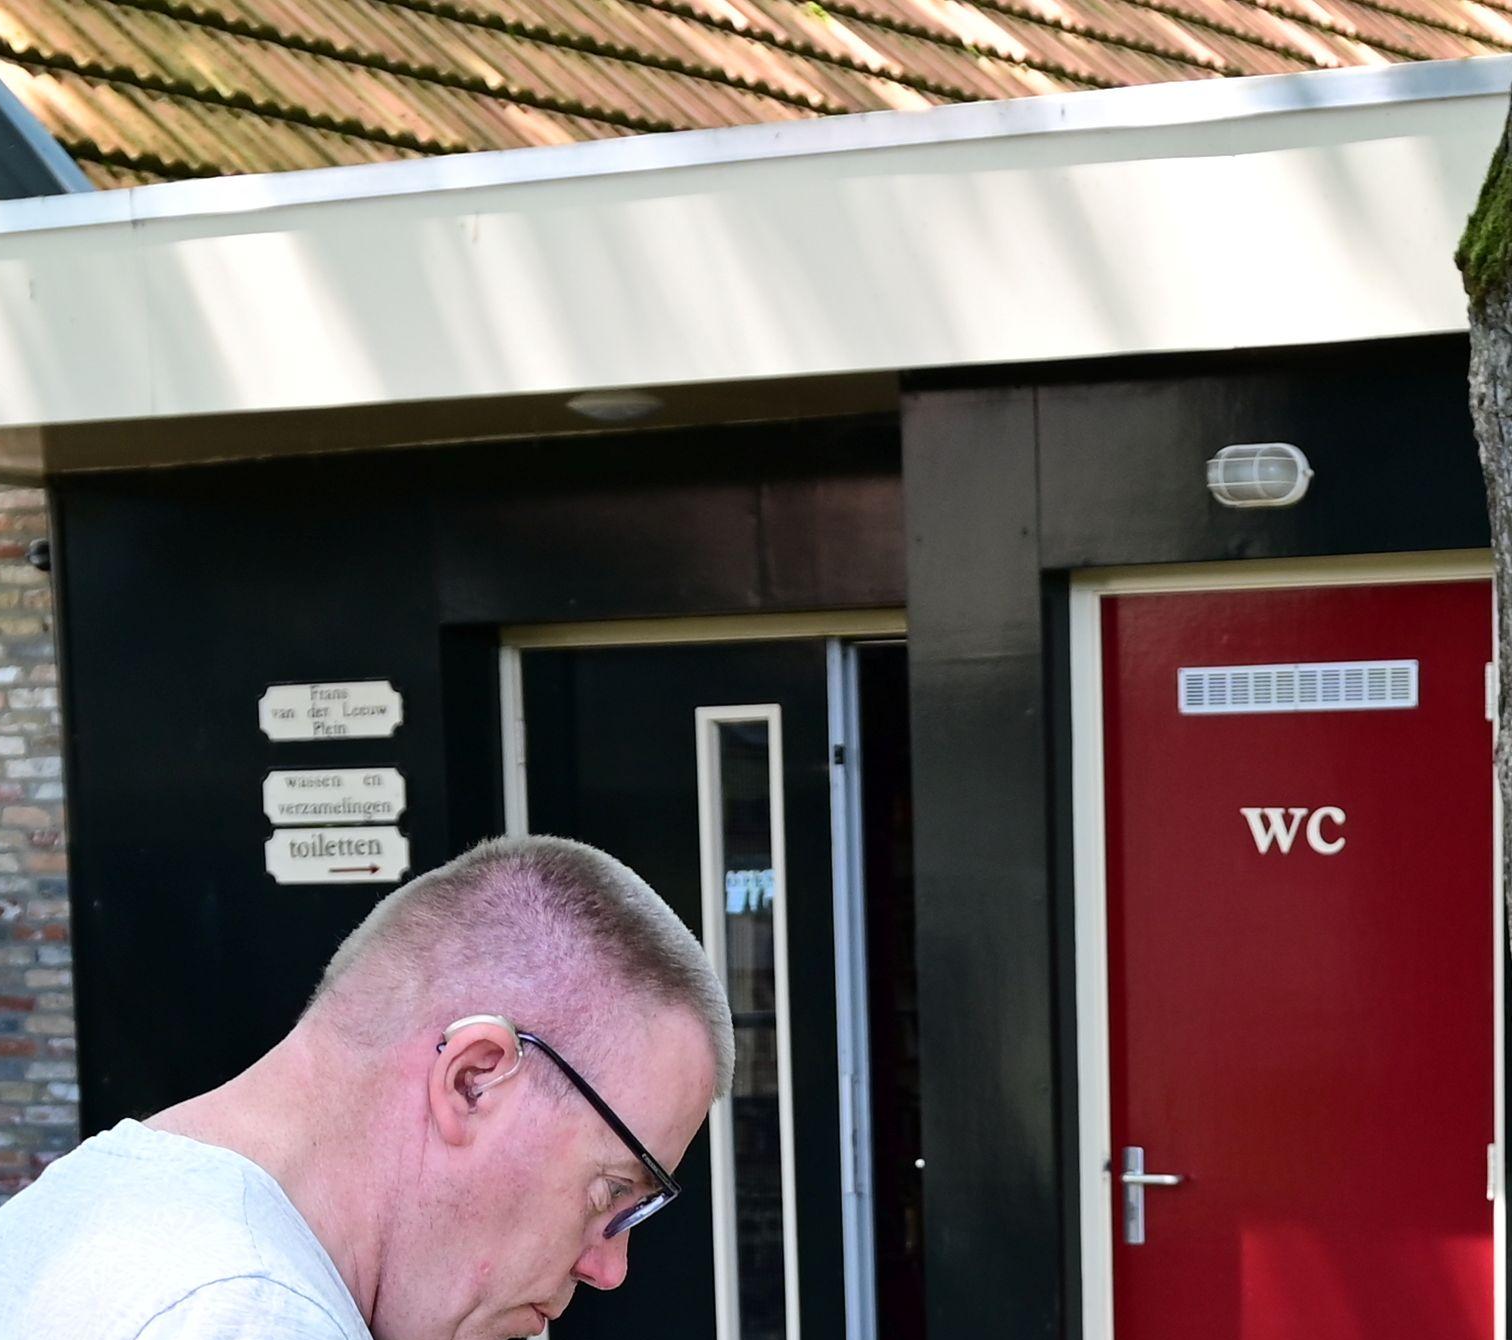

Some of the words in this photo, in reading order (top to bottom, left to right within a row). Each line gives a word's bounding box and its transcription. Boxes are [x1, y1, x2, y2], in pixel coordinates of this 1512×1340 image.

[271, 708, 295, 719] van
[307, 701, 331, 719] der
[313, 721, 349, 736] Plein
[363, 773, 383, 786] en
[279, 797, 392, 822] verzamelingen
[289, 833, 383, 858] toiletten
